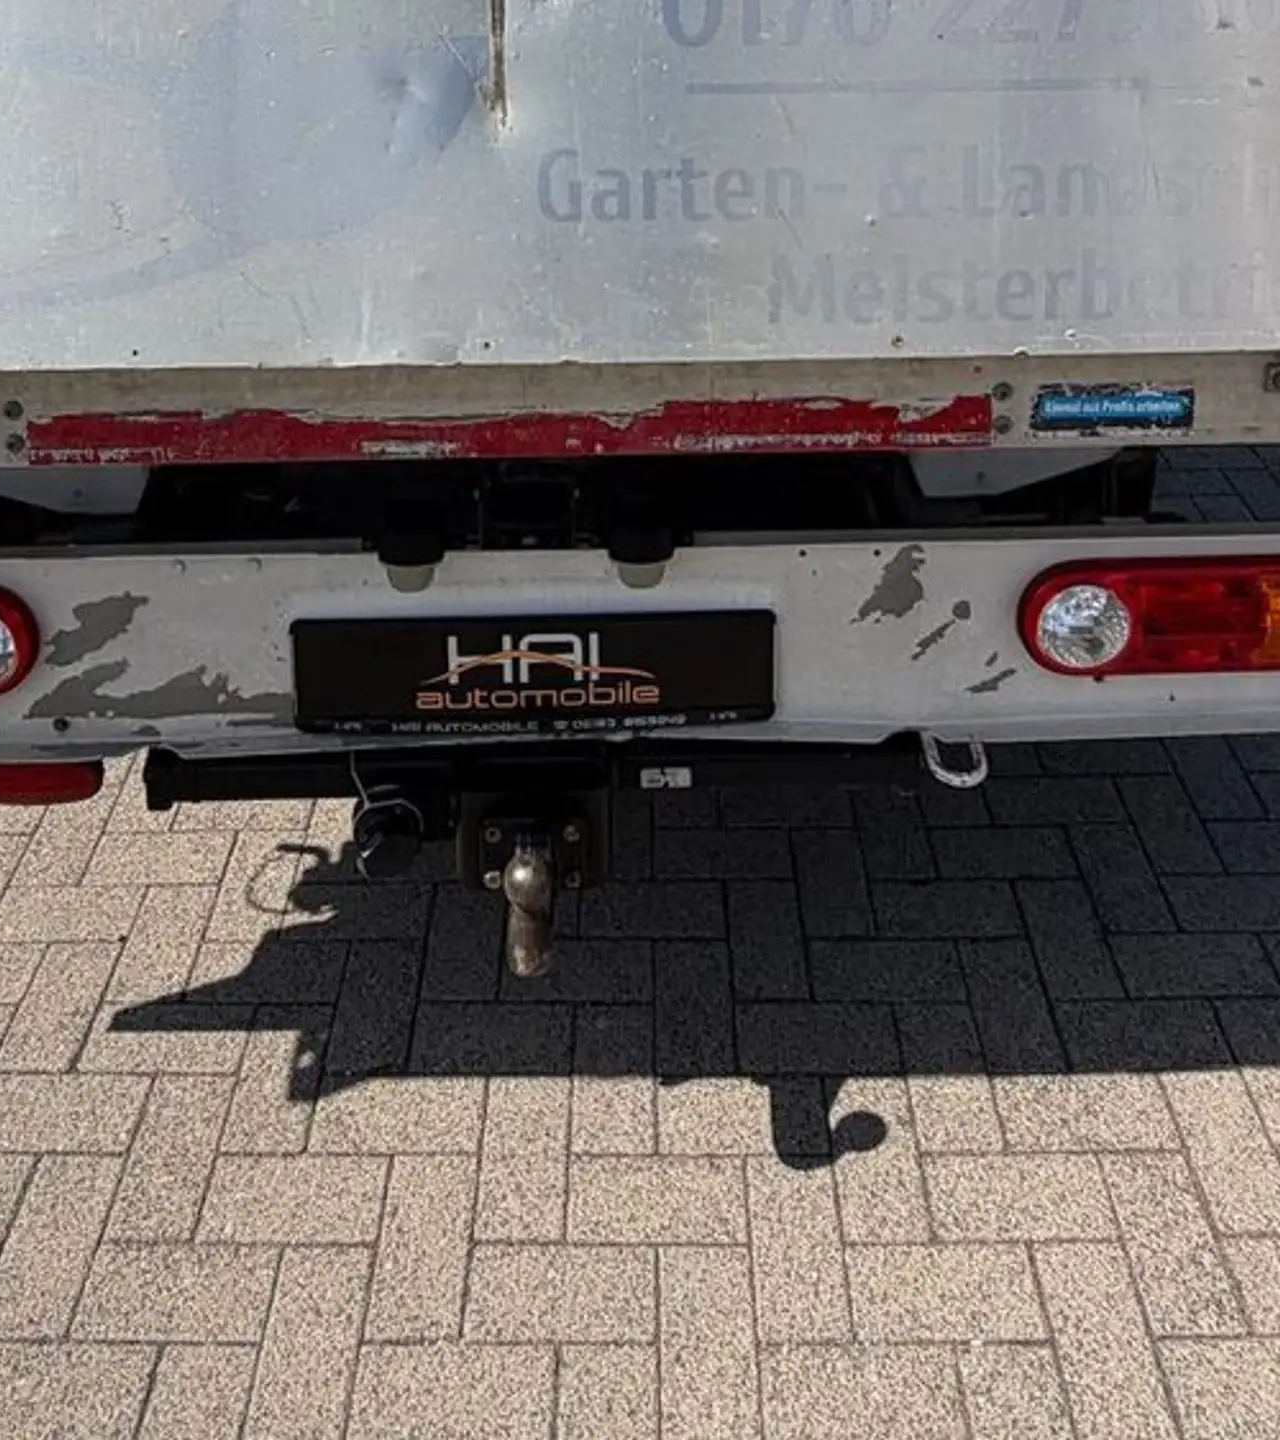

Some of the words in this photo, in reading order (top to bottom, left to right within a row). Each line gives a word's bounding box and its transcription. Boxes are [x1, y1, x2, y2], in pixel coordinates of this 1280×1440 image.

[535, 146, 848, 224] Garten-
[447, 630, 601, 685] HAI
[415, 679, 660, 711] automobile
